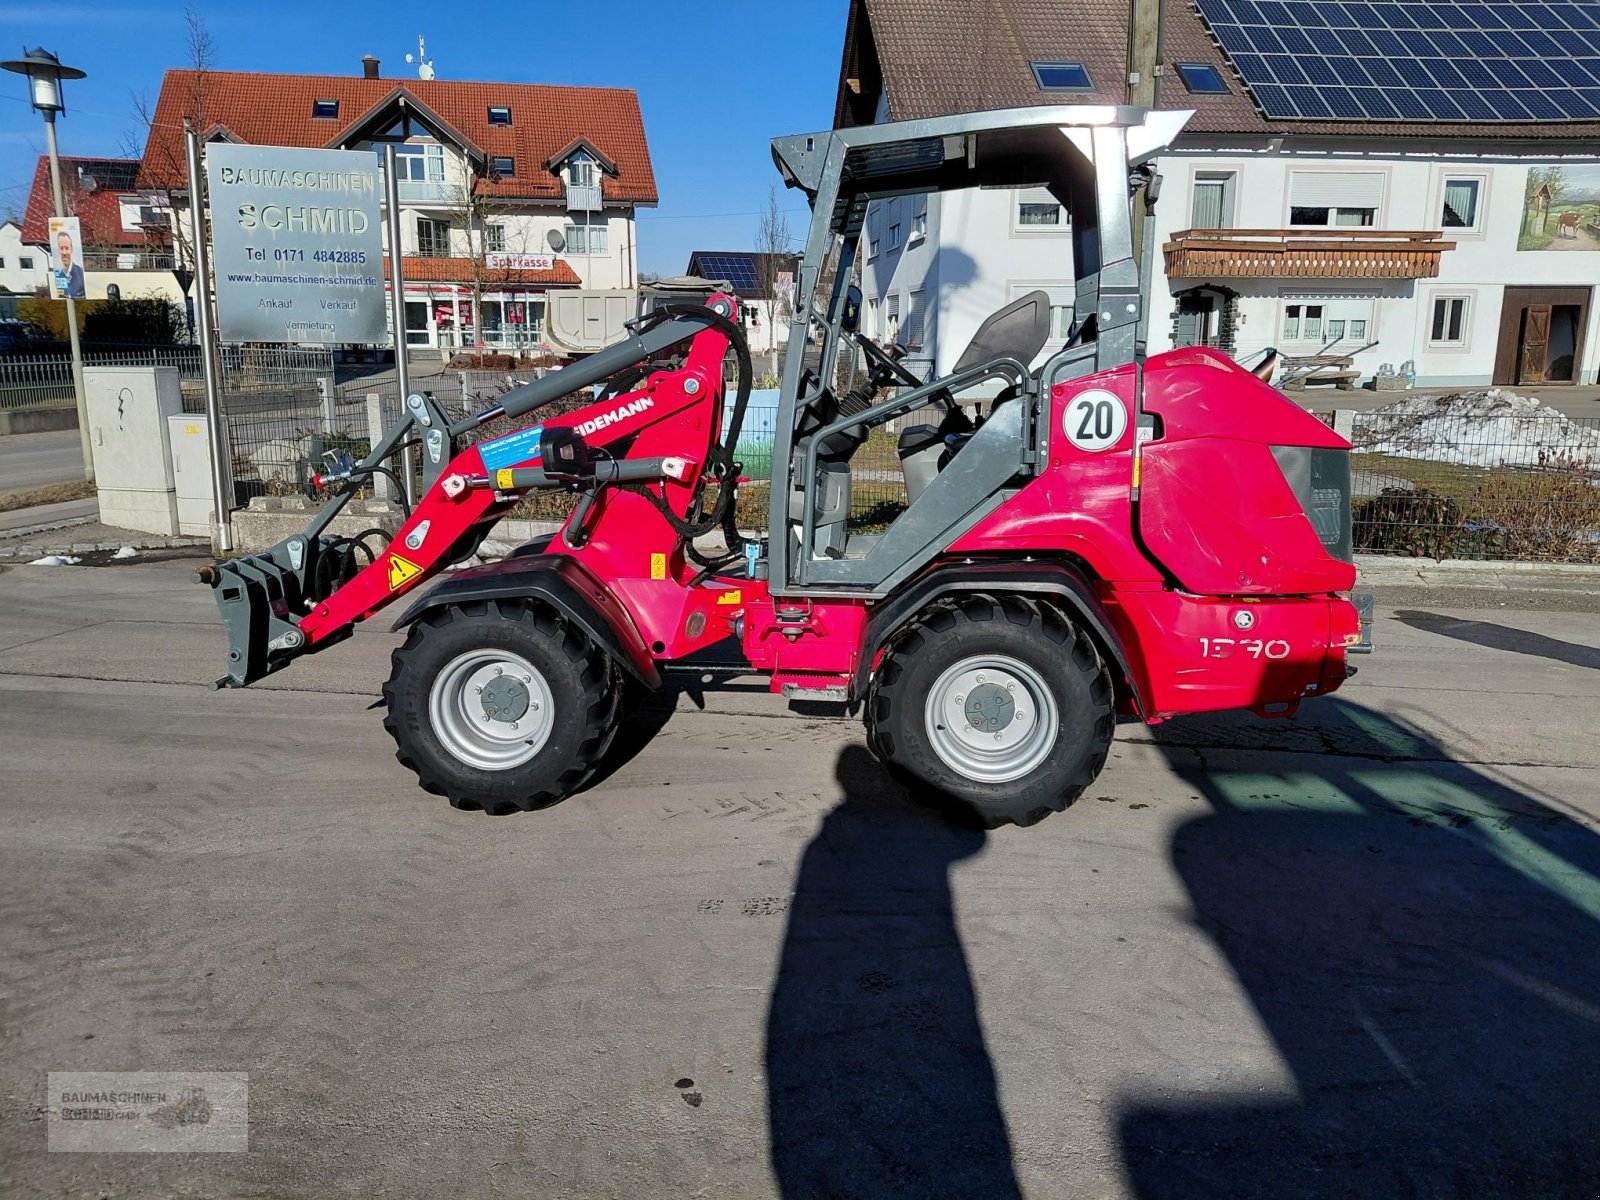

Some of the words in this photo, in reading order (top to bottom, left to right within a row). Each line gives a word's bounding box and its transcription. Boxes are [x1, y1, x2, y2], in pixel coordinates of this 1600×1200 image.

[221, 167, 375, 191] BAUMASCHINEN
[237, 203, 370, 234] SCHMID
[245, 247, 266, 261] Tel
[274, 249, 304, 262] 0171
[313, 250, 366, 264] 4842885
[491, 255, 548, 268] Sparkasse
[227, 273, 377, 286] www.baumaschinen-schmid.de
[258, 298, 293, 309] Ankauf
[319, 299, 357, 310] Verkauf
[284, 320, 336, 332] Vermietung
[573, 396, 655, 437] IDEMANN
[1076, 400, 1113, 440] 20
